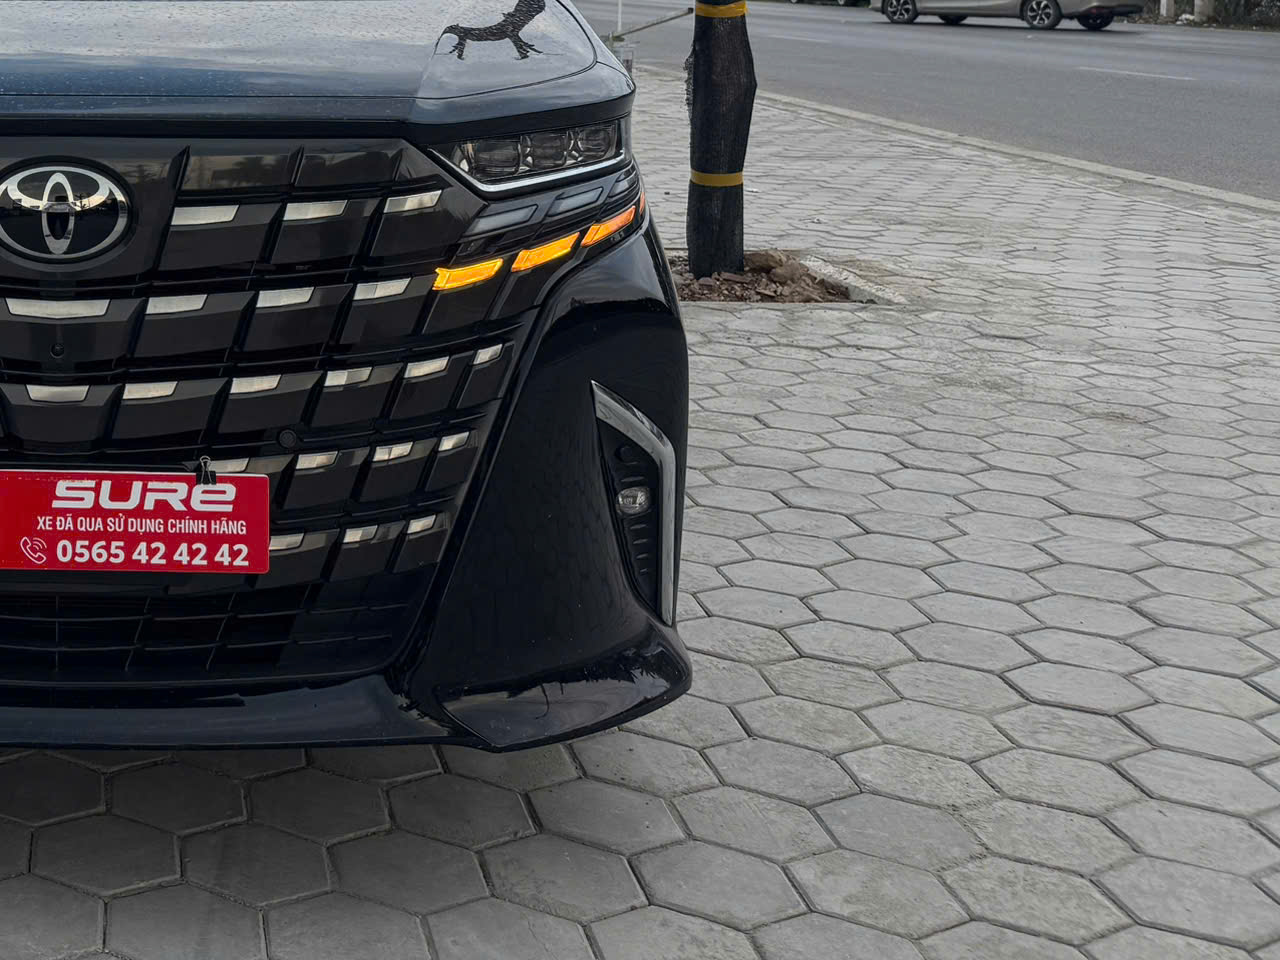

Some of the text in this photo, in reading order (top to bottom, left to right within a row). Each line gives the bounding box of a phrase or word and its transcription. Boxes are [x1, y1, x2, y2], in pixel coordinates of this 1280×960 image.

[37, 513, 247, 535] XE ĐÃ QUA SỬ DỤNG CHÍNH HÃNG
[56, 539, 249, 566] 0565 42 42 42
